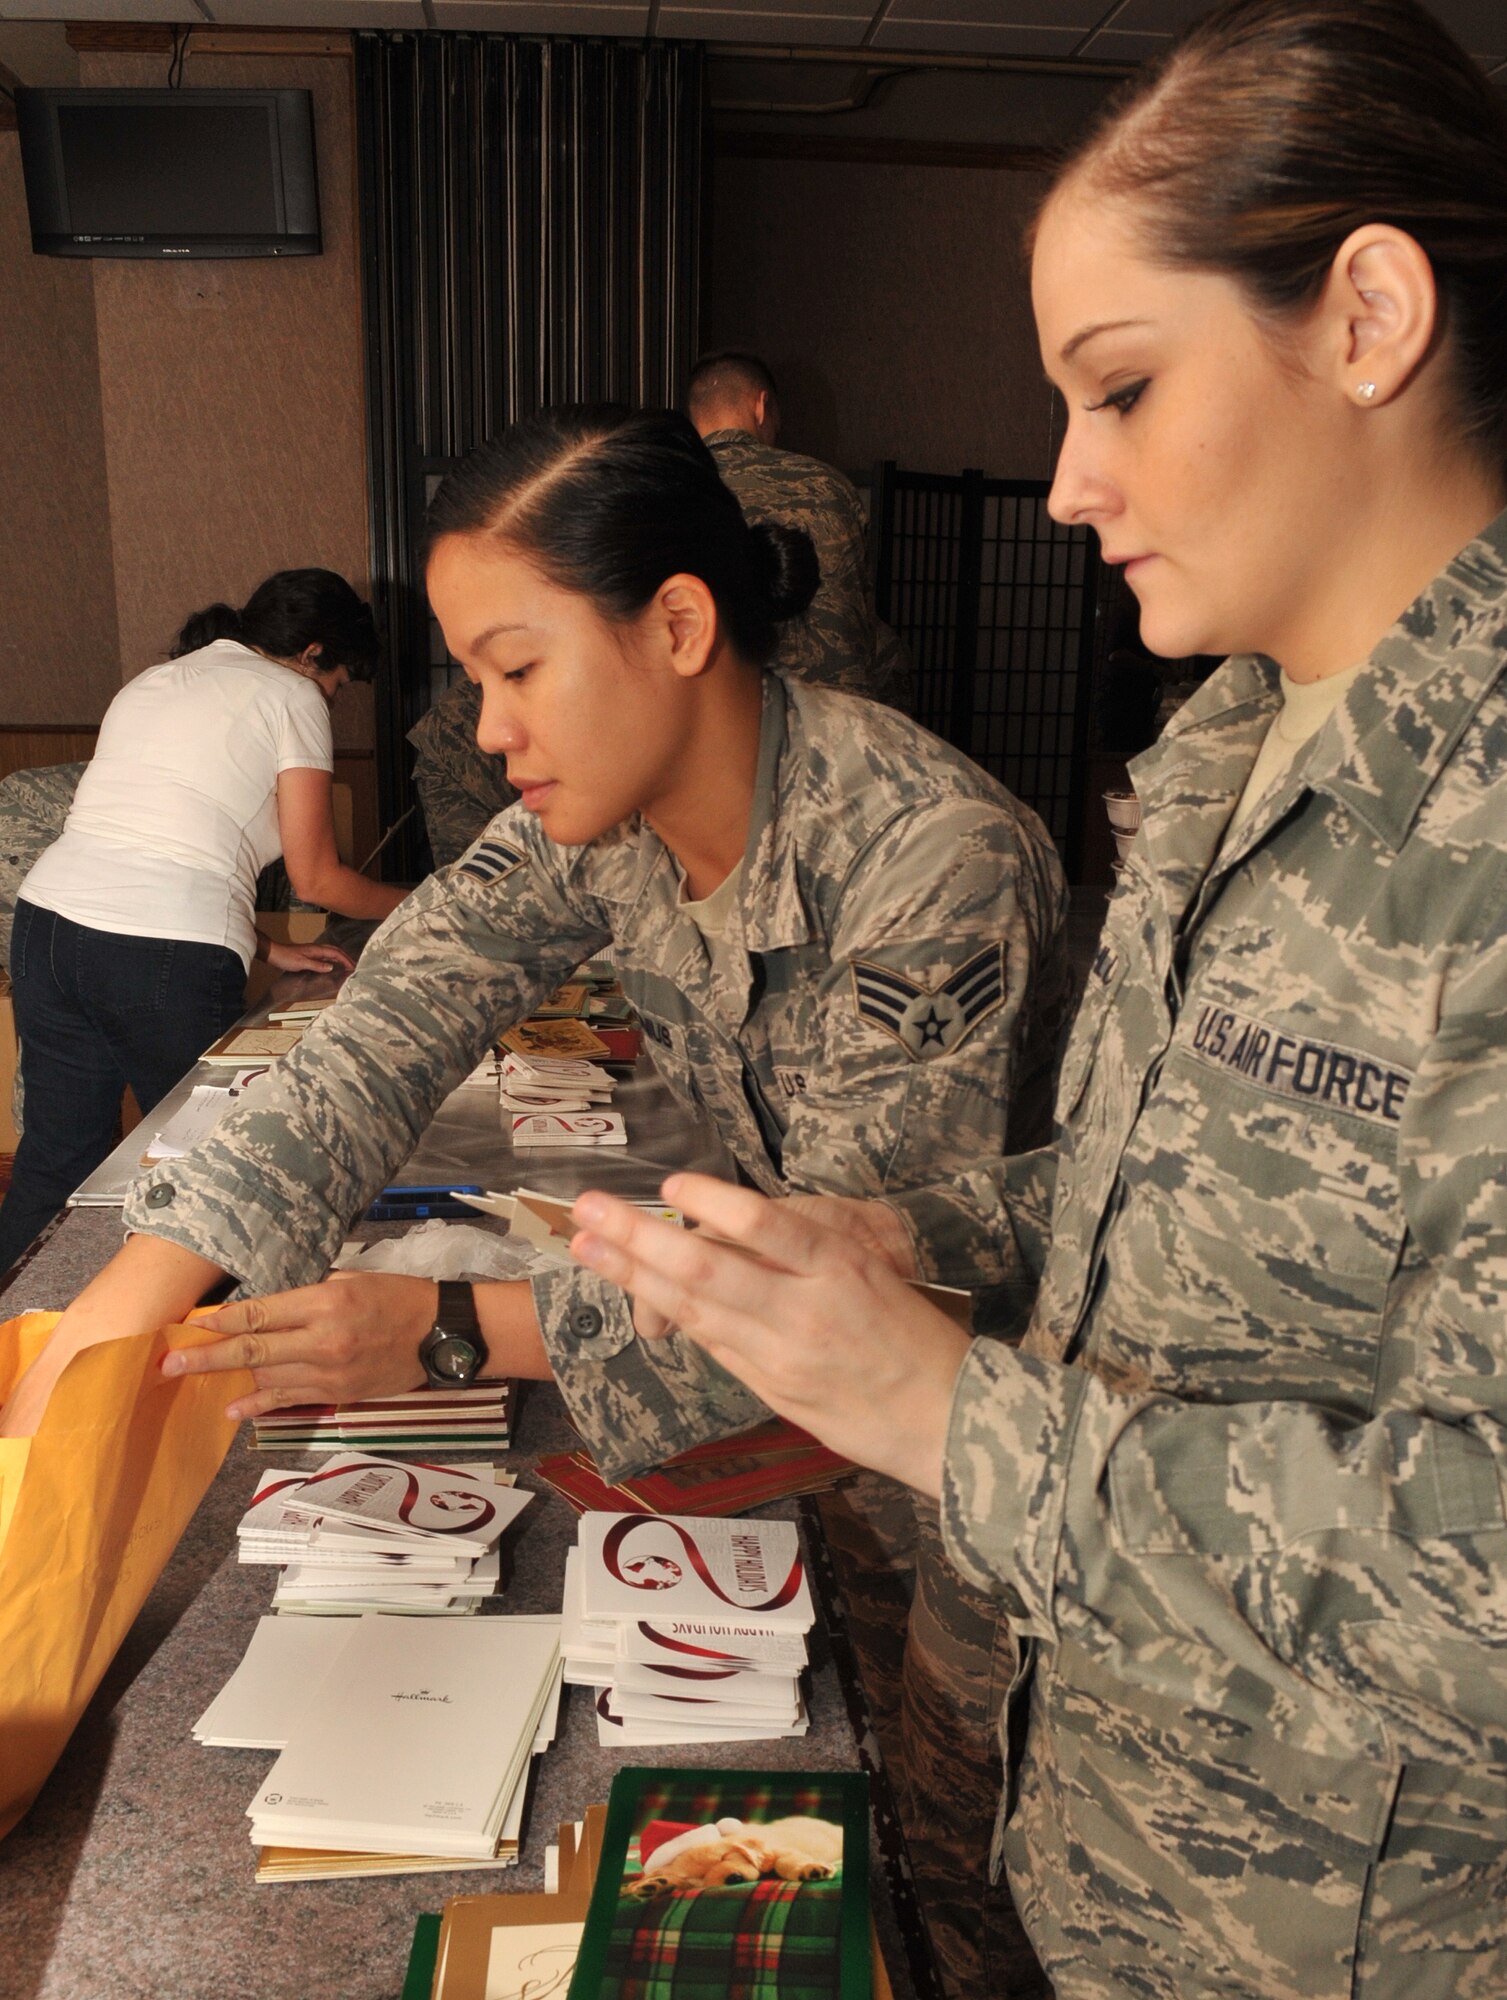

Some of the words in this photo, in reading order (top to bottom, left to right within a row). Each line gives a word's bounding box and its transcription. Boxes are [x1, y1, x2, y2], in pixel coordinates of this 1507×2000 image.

[1192, 1006, 1234, 1061] U.S.
[1228, 1022, 1270, 1079] AIR
[1266, 1035, 1411, 1121] FORCE
[350, 1472, 393, 1495] HOLIDAYS
[336, 1488, 373, 1507] HAPPY
[730, 1535, 762, 1560] HAPPY
[734, 1559, 768, 1592] HOLIDAYS
[391, 1692, 453, 1703] Hallmark
